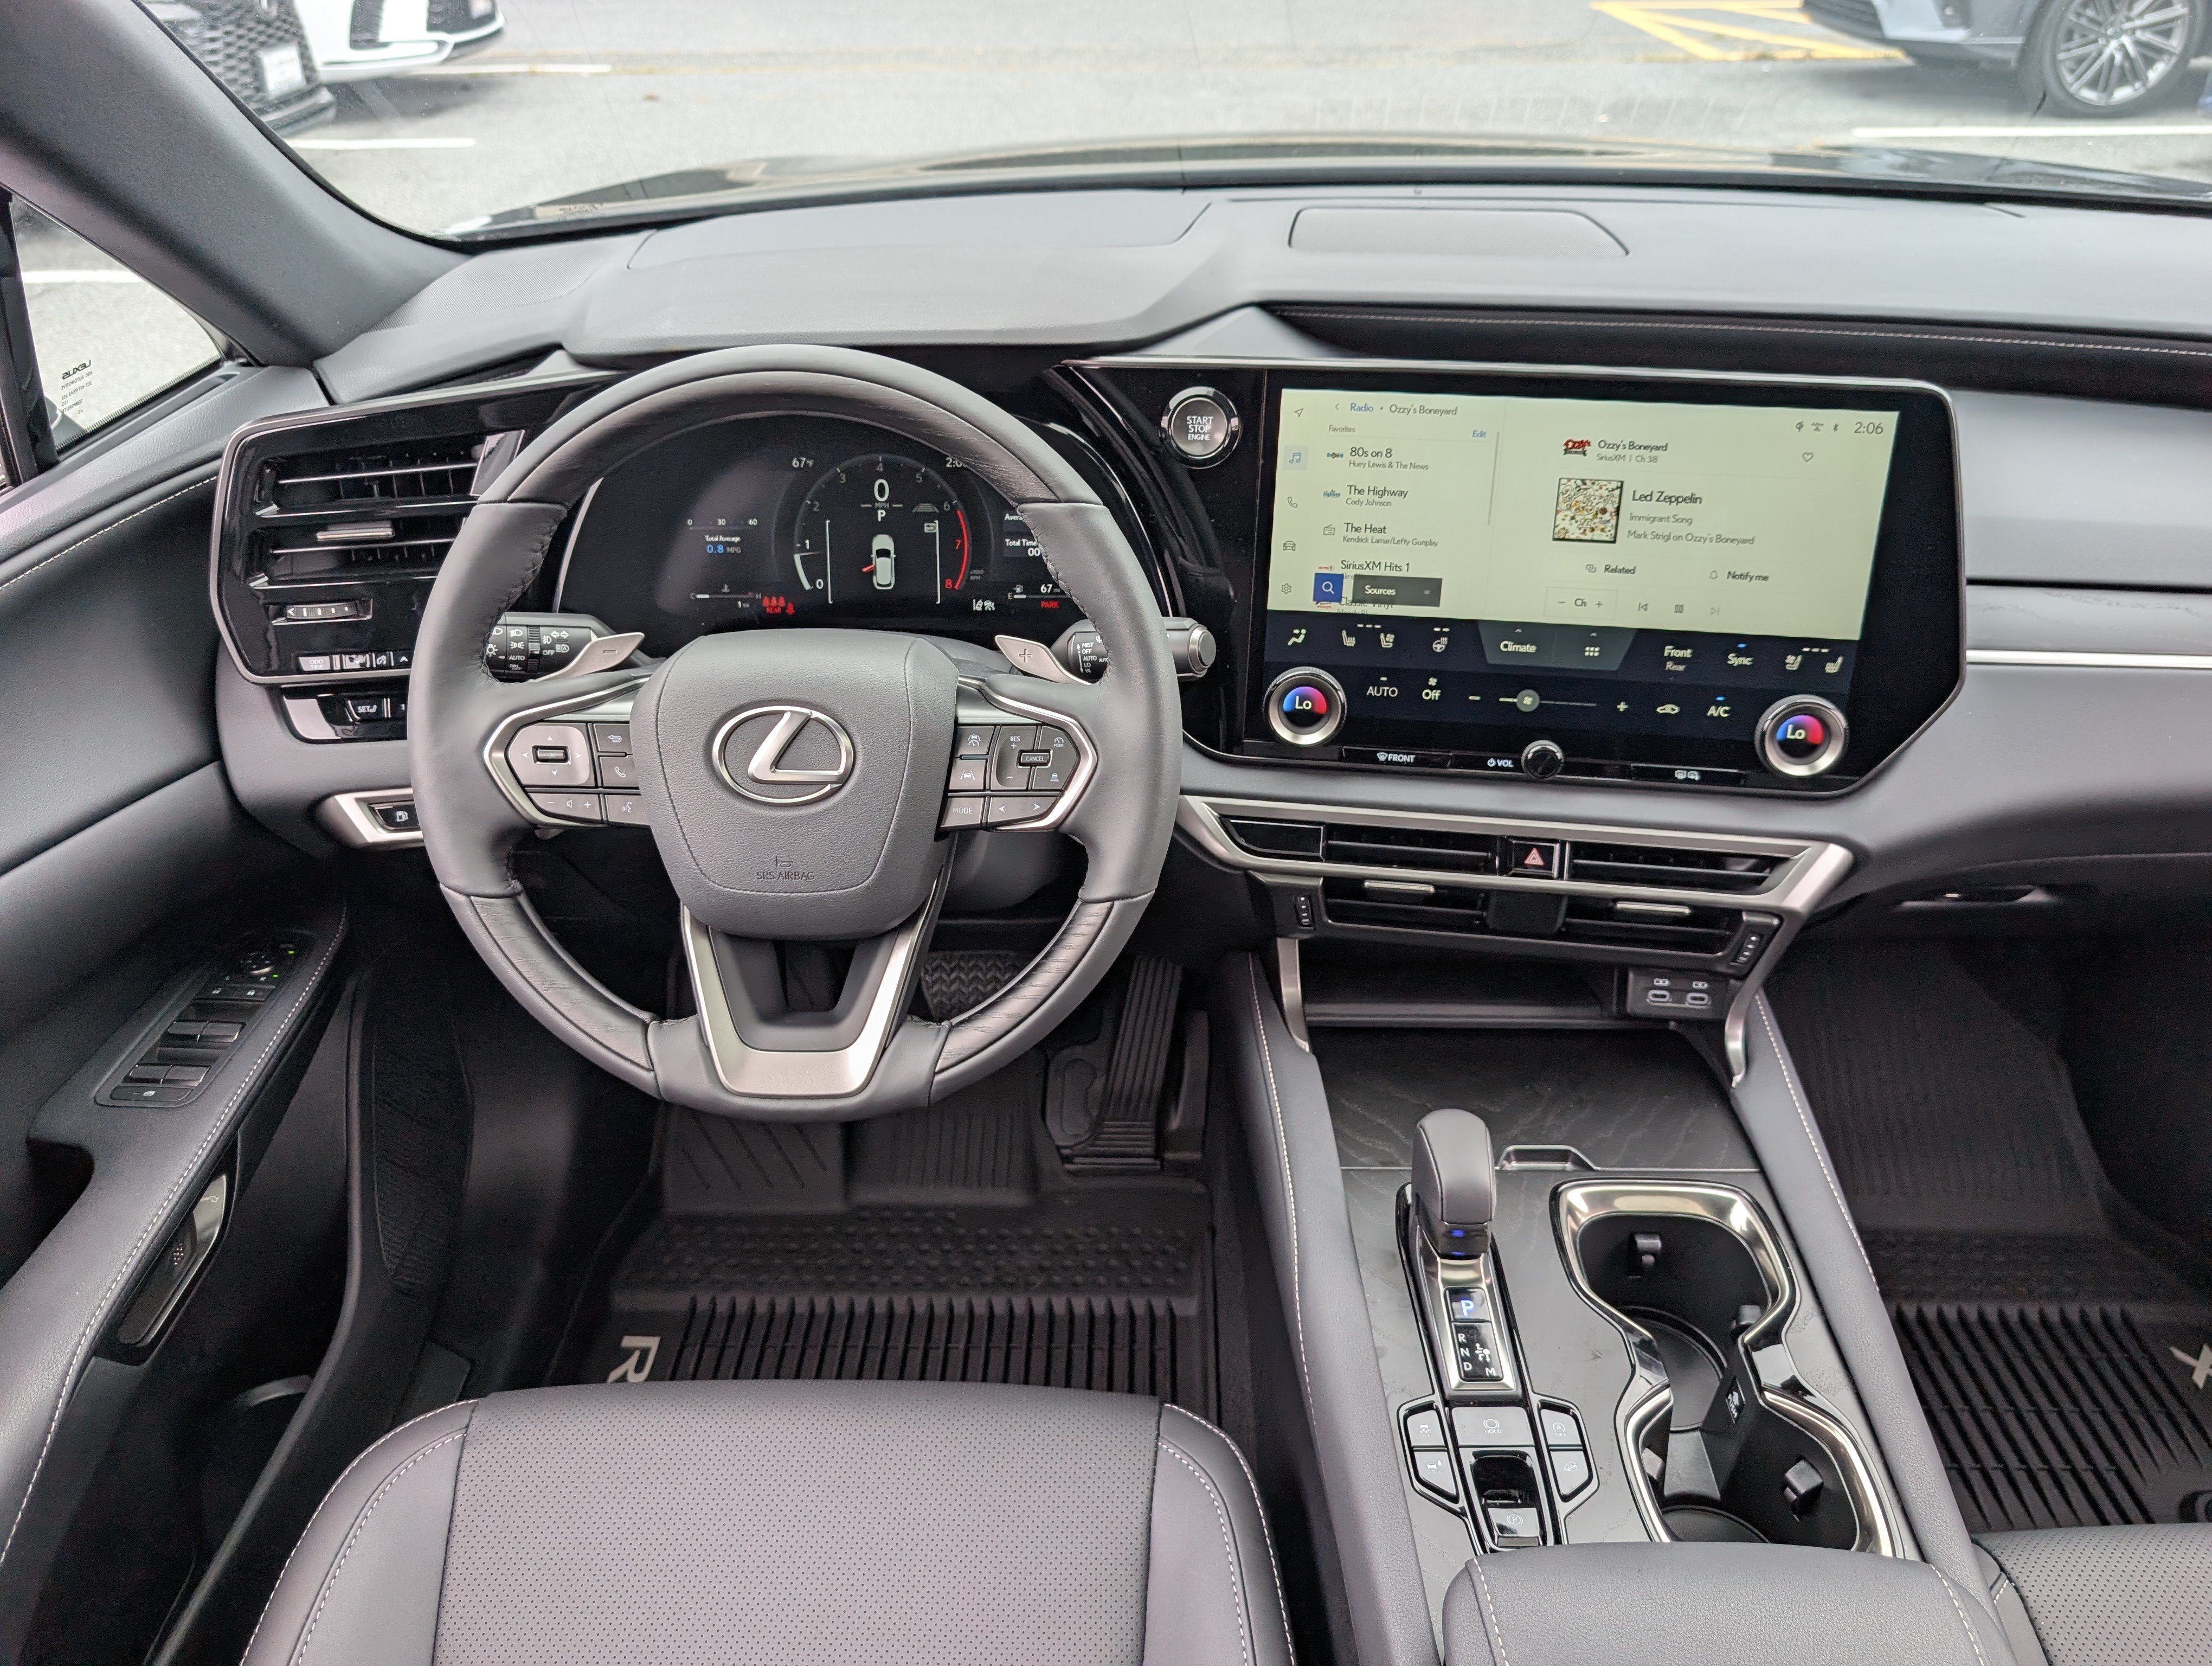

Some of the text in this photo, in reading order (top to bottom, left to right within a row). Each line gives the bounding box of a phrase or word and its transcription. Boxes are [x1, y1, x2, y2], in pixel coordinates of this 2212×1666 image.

[1350, 403, 1458, 417] Radio Ozzy's Boneyard
[1186, 415, 1213, 425] START
[1188, 424, 1211, 433] STOP
[1328, 425, 1356, 433] Favorites
[1854, 421, 1883, 435] 2:06
[1472, 430, 1487, 438] Edit
[1598, 440, 1669, 453] Ozzy's Boneyard
[1349, 447, 1369, 457] 80s
[1384, 448, 1392, 458] 8
[946, 457, 968, 468] 2:0
[1635, 454, 1645, 463] Ch
[1349, 460, 1367, 469] Huey
[1368, 460, 1386, 469] Lewis
[1395, 462, 1408, 470] The
[1409, 463, 1429, 471] News
[839, 473, 847, 483] 3
[915, 473, 922, 483] 5
[873, 478, 890, 502] 0
[1347, 485, 1409, 499] The Highway
[1346, 498, 1392, 507] Cody Johnson
[1632, 490, 1702, 506] Led Zeppelin
[813, 501, 820, 511] 2
[943, 502, 951, 511] 6
[877, 509, 886, 522] P
[1629, 513, 1693, 526] Immigrant Song
[1344, 522, 1387, 534] The Heat
[1021, 539, 1038, 547] Time
[1343, 535, 1438, 548] Kendrick Lamar/Lefty Gunplay
[1627, 530, 1648, 540] Mark
[1685, 533, 1714, 544] Ozzy's
[1715, 534, 1756, 546] Boneyard
[706, 544, 724, 554] 0.8
[805, 539, 810, 550] 1
[955, 540, 961, 550] 7
[1027, 548, 1041, 557] 00
[1341, 560, 1410, 573] SiriusXM Hits 1
[1604, 564, 1636, 575] Related
[1727, 571, 1754, 582] Notify
[815, 579, 824, 589] 0
[945, 579, 953, 589] 8
[1040, 584, 1053, 593] 67
[1365, 585, 1396, 596] Sources
[1574, 598, 1586, 607] Ch
[1500, 641, 1536, 653] Climate
[1664, 645, 1693, 658] Front
[1727, 653, 1753, 667] Sync
[1666, 661, 1686, 671] Rear
[1366, 686, 1398, 697] AUTO
[1422, 689, 1441, 701] Off
[1295, 695, 1312, 710] Lo
[1707, 706, 1731, 717] A/C
[1786, 725, 1807, 740] Lo
[1388, 754, 1416, 763] FRONT
[1497, 759, 1514, 767] VOL
[757, 871, 815, 881] SRS AIRBAG
[1461, 1299, 1474, 1317] P
[1458, 1334, 1467, 1343] R
[1460, 1347, 1470, 1356] N
[1464, 1362, 1472, 1371] D
[1486, 1367, 1495, 1376] M
